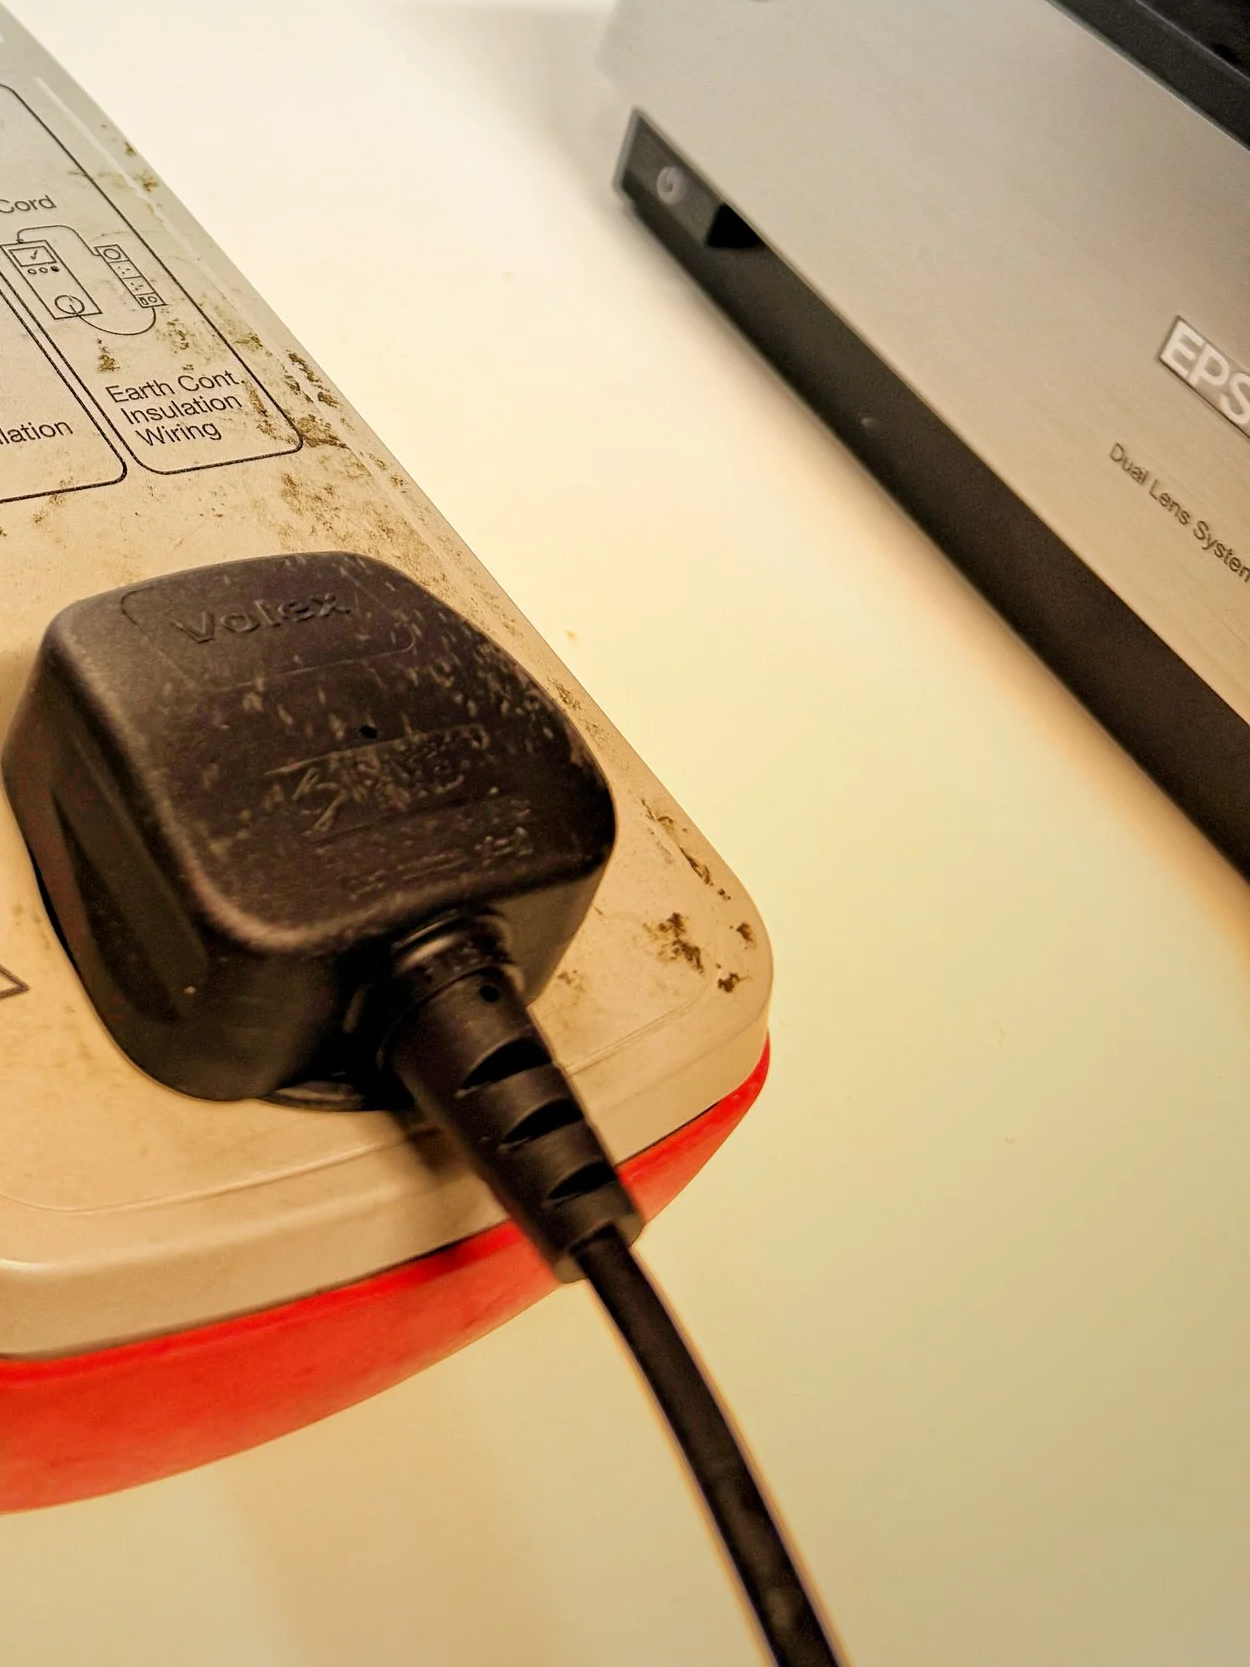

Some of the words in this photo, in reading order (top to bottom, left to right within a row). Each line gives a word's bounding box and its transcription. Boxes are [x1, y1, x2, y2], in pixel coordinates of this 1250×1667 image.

[105, 379, 175, 403] Earth
[178, 370, 245, 392] Cont.
[121, 395, 243, 424] Insulation
[135, 422, 222, 446] Wiring
[1109, 442, 1149, 485] Dual
[1149, 479, 1190, 526] Lens
[171, 593, 351, 644] Volex
